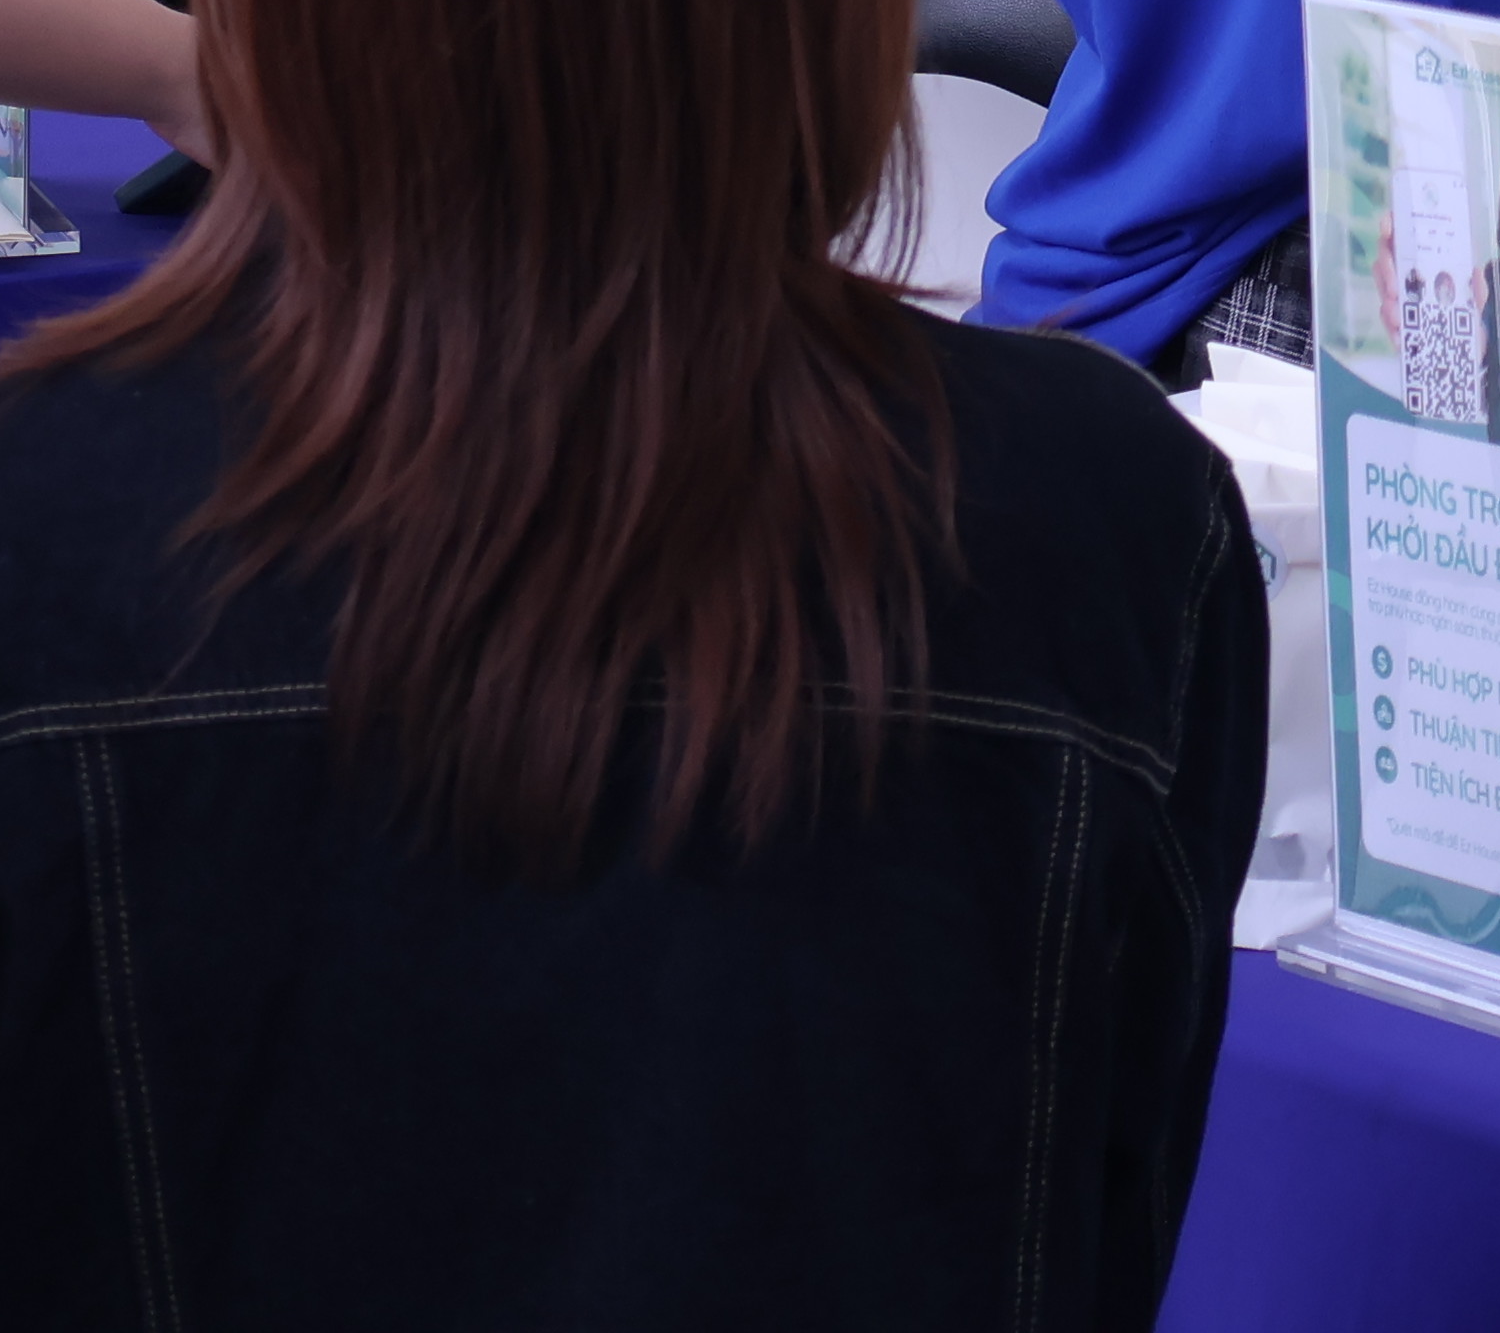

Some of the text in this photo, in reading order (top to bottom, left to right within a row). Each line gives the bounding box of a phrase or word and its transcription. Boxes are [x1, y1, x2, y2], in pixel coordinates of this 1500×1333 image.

[1364, 461, 1456, 517] PHÒNG
[1366, 514, 1428, 562] KHỞI
[1434, 524, 1488, 578] ĐẦU
[1407, 655, 1447, 690] PHÙ
[1451, 665, 1493, 703] HỢP
[1409, 709, 1476, 753] THUẬN
[1411, 761, 1455, 798] TIỆN
[1458, 772, 1491, 806] ÍCH
